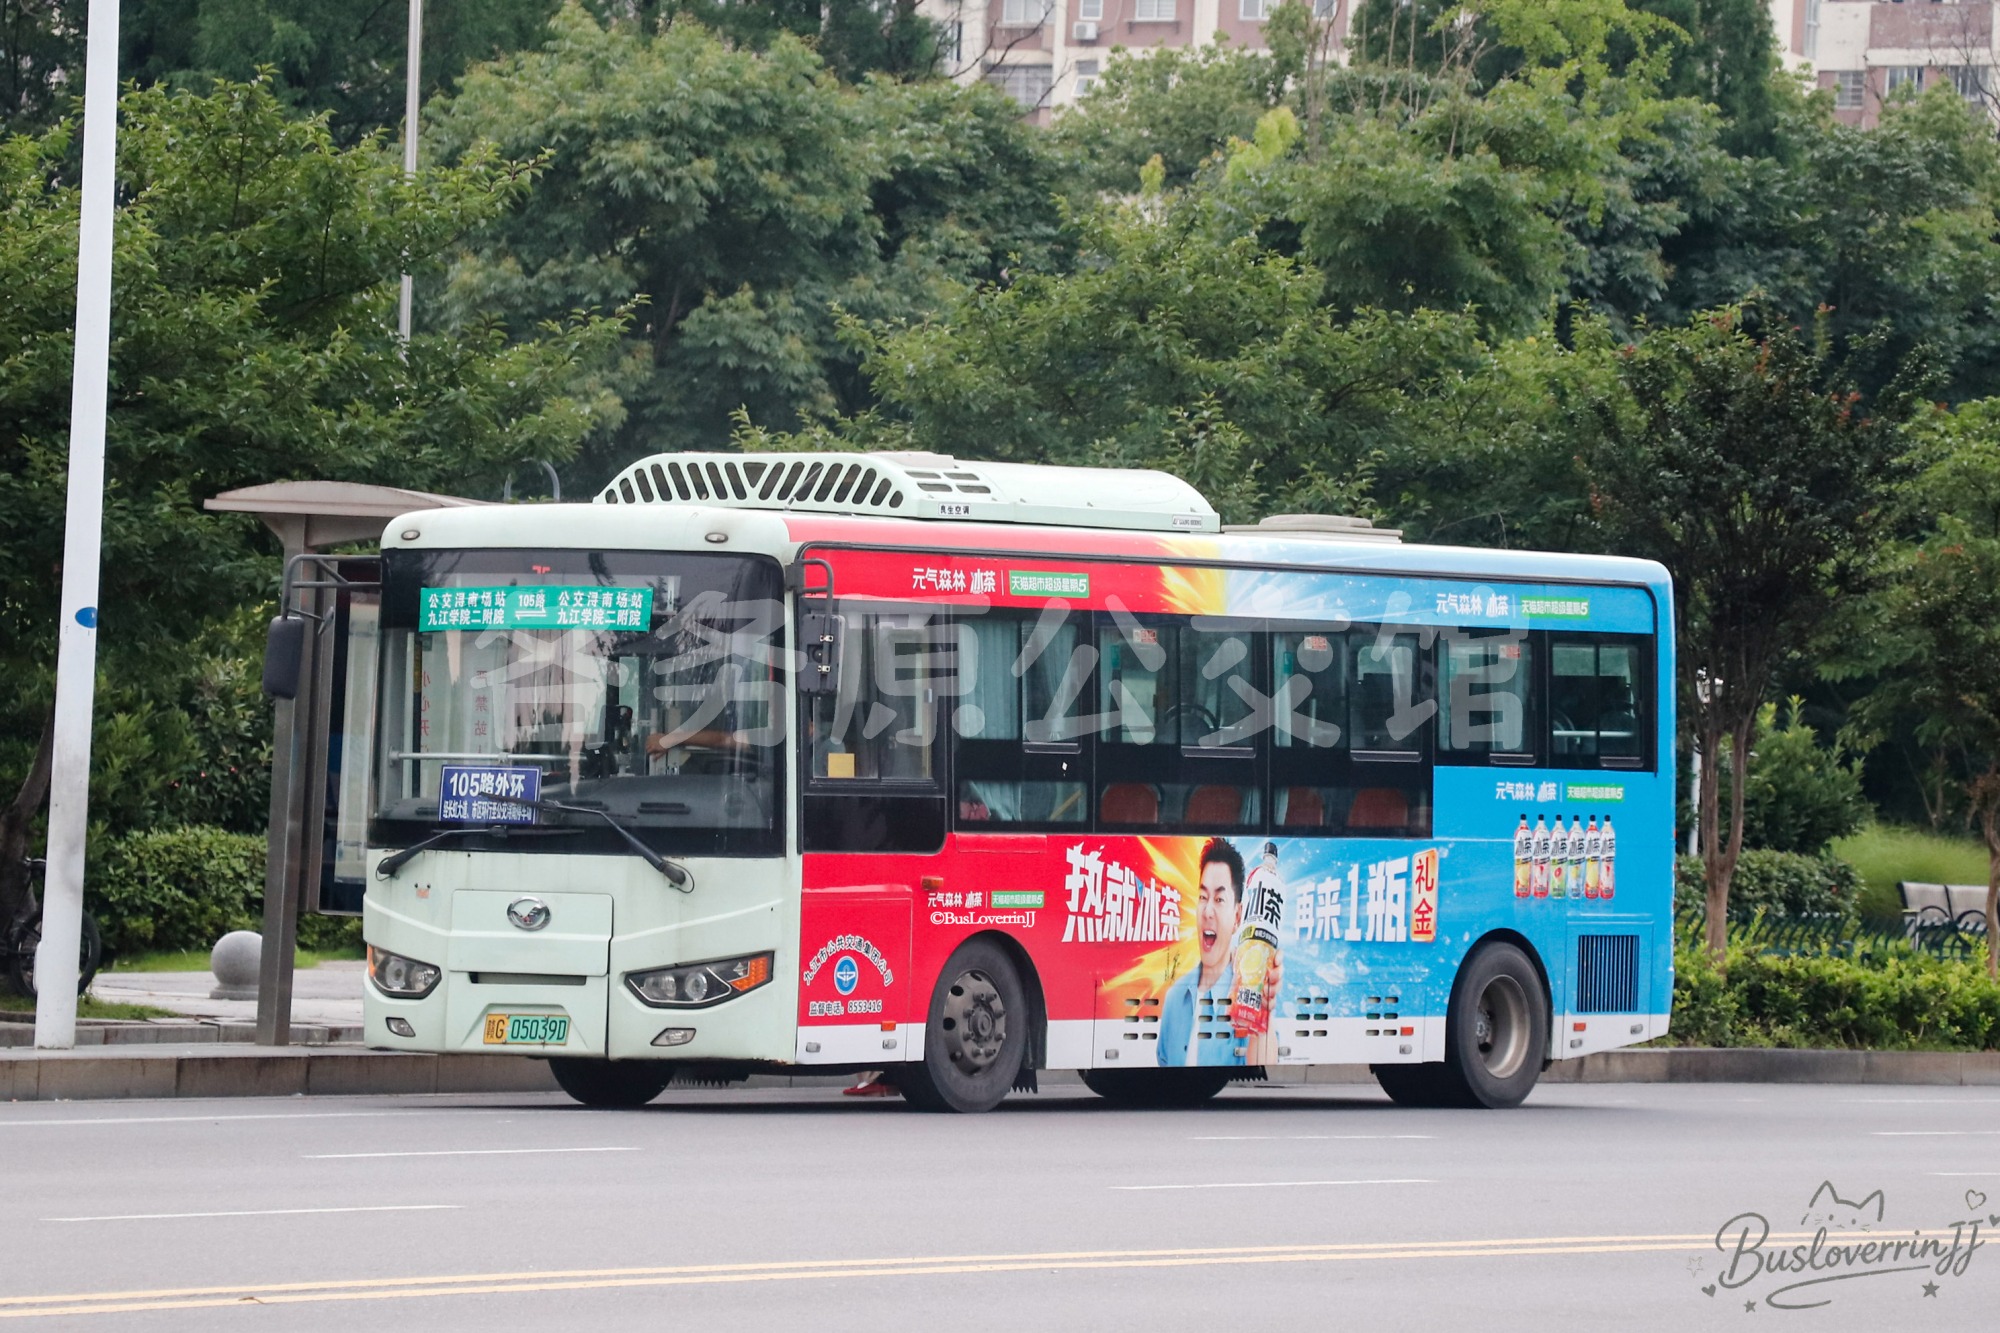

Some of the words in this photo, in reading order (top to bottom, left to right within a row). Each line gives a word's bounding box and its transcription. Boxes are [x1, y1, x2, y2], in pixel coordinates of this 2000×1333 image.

[912, 567, 966, 593] 元气森林
[1011, 575, 1088, 593] 天猫超市超级星期5
[428, 592, 506, 609] 公交浔南场站
[518, 593, 546, 609] 105路
[558, 591, 643, 609] 公交浔南场站
[1436, 593, 1483, 616] 元气森林
[427, 609, 505, 626] 九江学院二附院
[556, 608, 642, 626] 九江学院二附院
[449, 772, 526, 799] 105路外环
[1495, 781, 1535, 801] 元气森林
[927, 892, 963, 908] 元气森林
[1061, 841, 1182, 943] 热就冰茶
[1295, 855, 1408, 943] 再来1瓶
[1414, 853, 1435, 936] 礼金
[803, 933, 894, 988] 九江市公共交通集团公司
